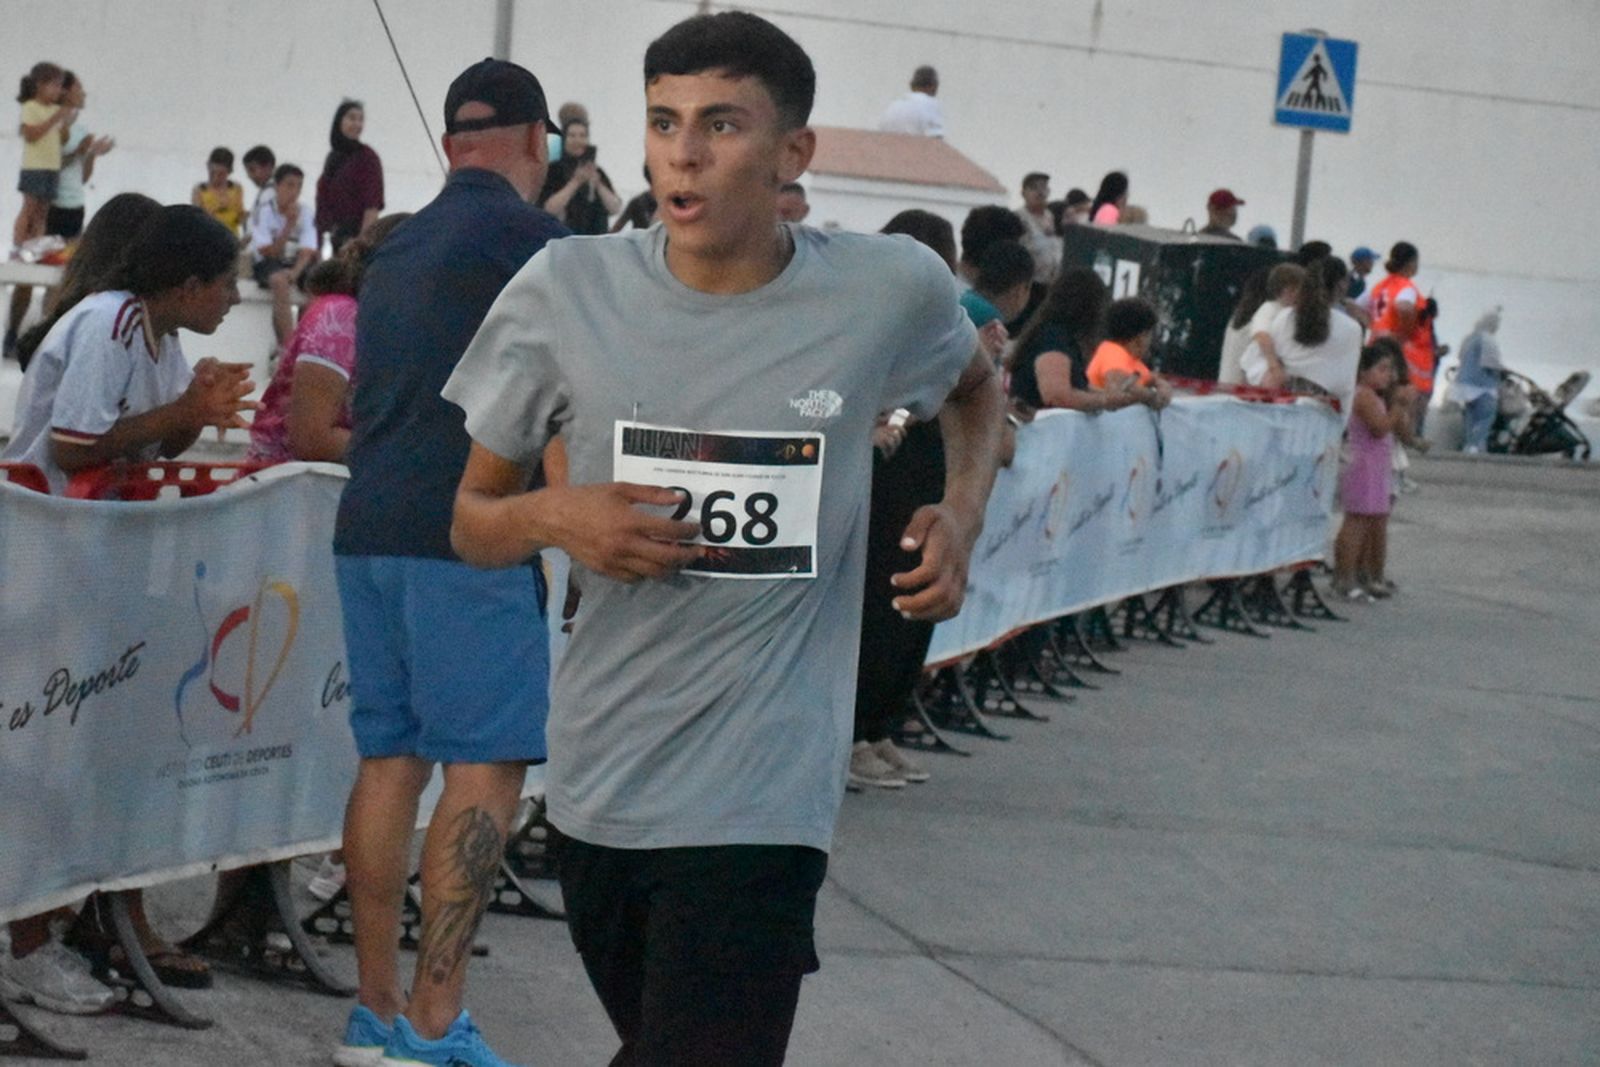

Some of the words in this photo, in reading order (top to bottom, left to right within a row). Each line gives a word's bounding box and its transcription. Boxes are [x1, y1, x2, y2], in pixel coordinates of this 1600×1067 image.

[8, 701, 35, 731] es
[42, 641, 147, 727] Deporte
[246, 743, 292, 764] DEPORTES
